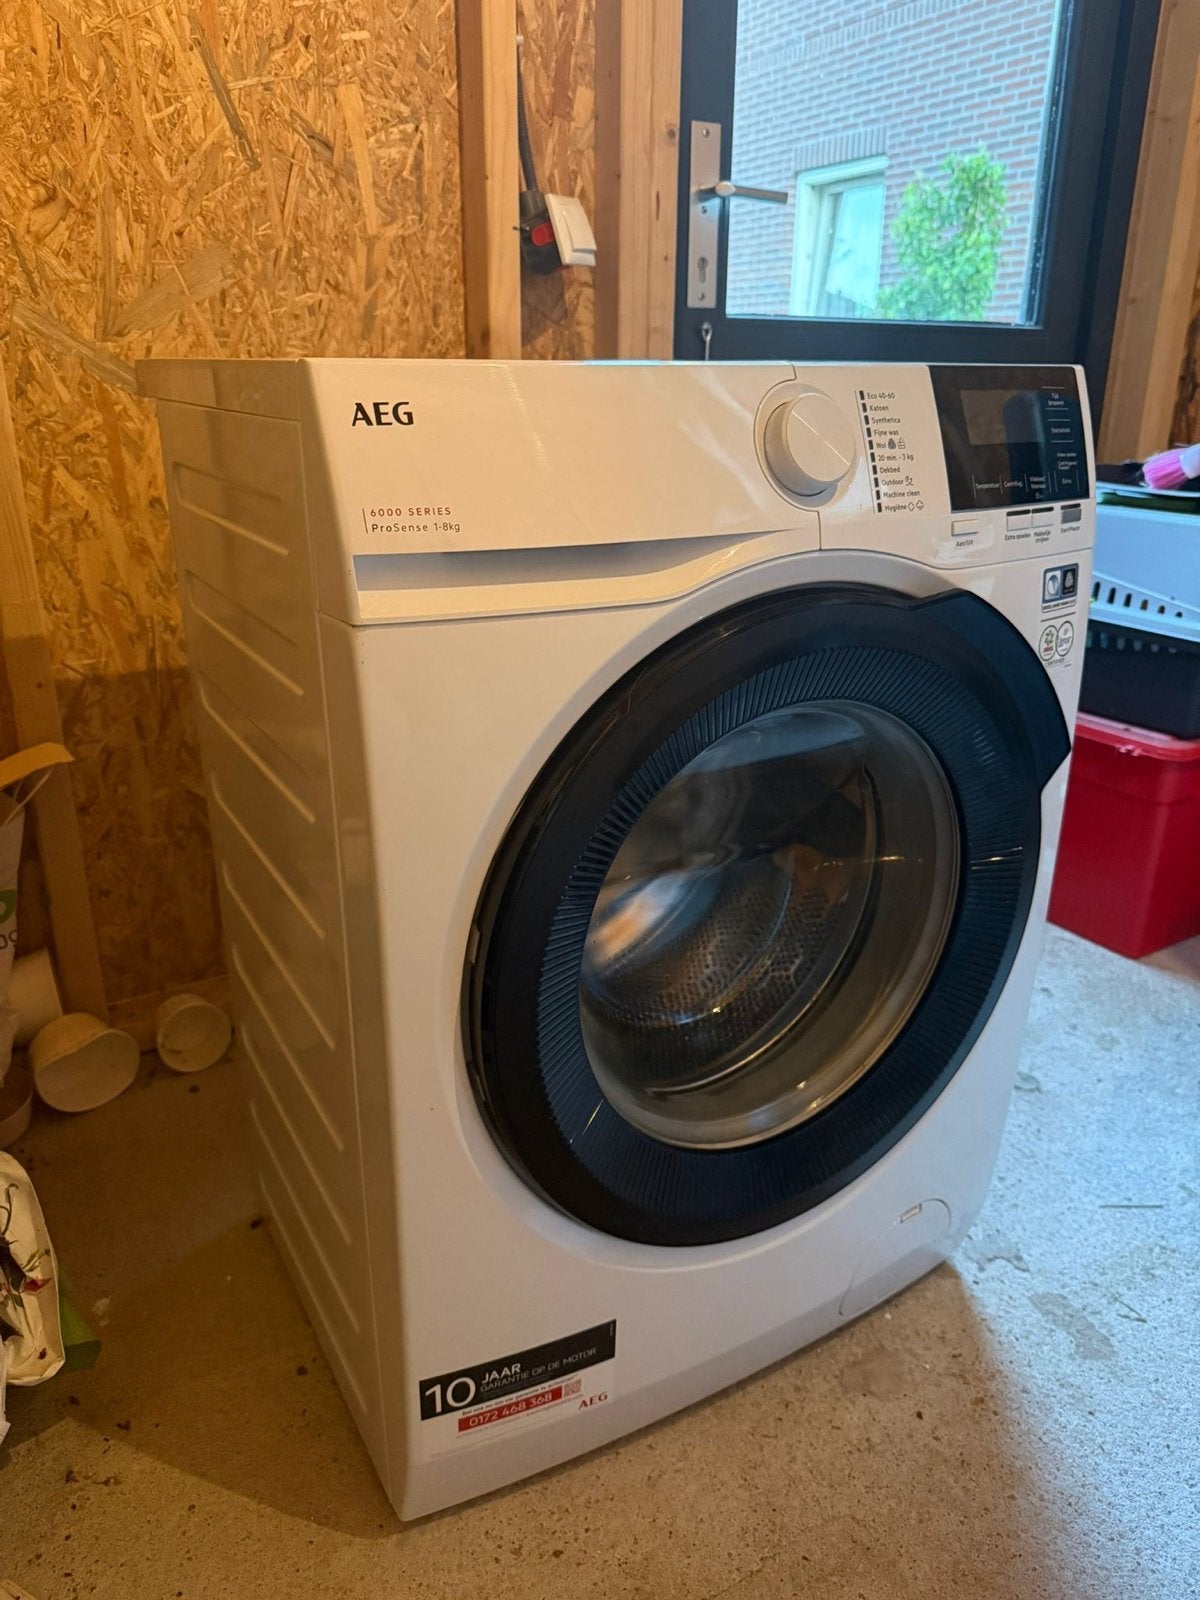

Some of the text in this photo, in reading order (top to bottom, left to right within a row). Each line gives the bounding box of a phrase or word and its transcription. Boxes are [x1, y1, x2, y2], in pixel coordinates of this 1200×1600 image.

[352, 401, 414, 426] AEG
[872, 417, 901, 425] Synthetica
[874, 429, 887, 438] Fijne
[907, 453, 914, 461] kg
[370, 507, 452, 517] 6000 SERIES
[372, 522, 460, 533] ProSense 1-8kg
[480, 1371, 530, 1392] GARANTIE
[532, 1366, 546, 1376] OP
[547, 1359, 560, 1370] DE
[563, 1348, 597, 1364] MOTOR
[482, 1362, 521, 1384] JAAR
[424, 1377, 476, 1414] 10
[578, 1390, 608, 1410] AEG
[470, 1392, 552, 1426] 0172 468 368
